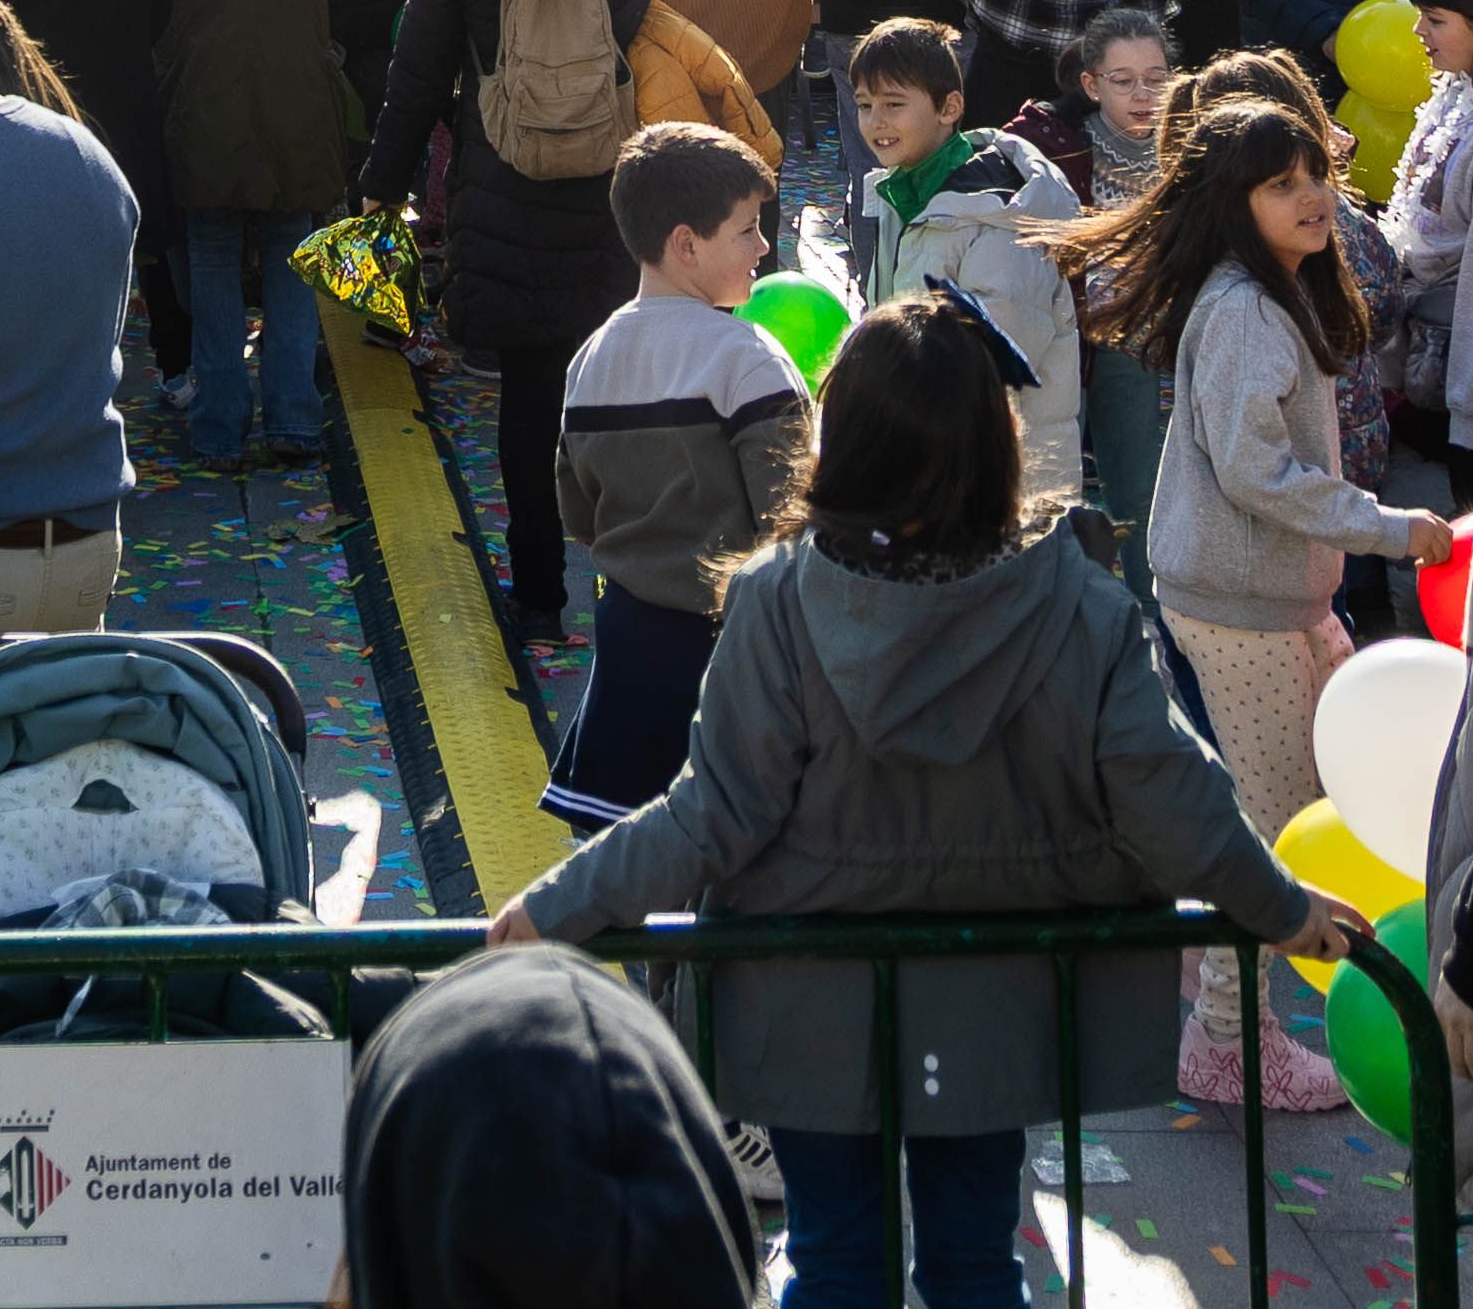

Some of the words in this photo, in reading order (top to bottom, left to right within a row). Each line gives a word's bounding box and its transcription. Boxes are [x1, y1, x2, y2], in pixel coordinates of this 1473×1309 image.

[85, 1154, 201, 1176] Ajuntament
[207, 1152, 232, 1171] de
[86, 1177, 233, 1203] Cerdanyola
[243, 1176, 281, 1198] del
[290, 1174, 345, 1197] Vallè
